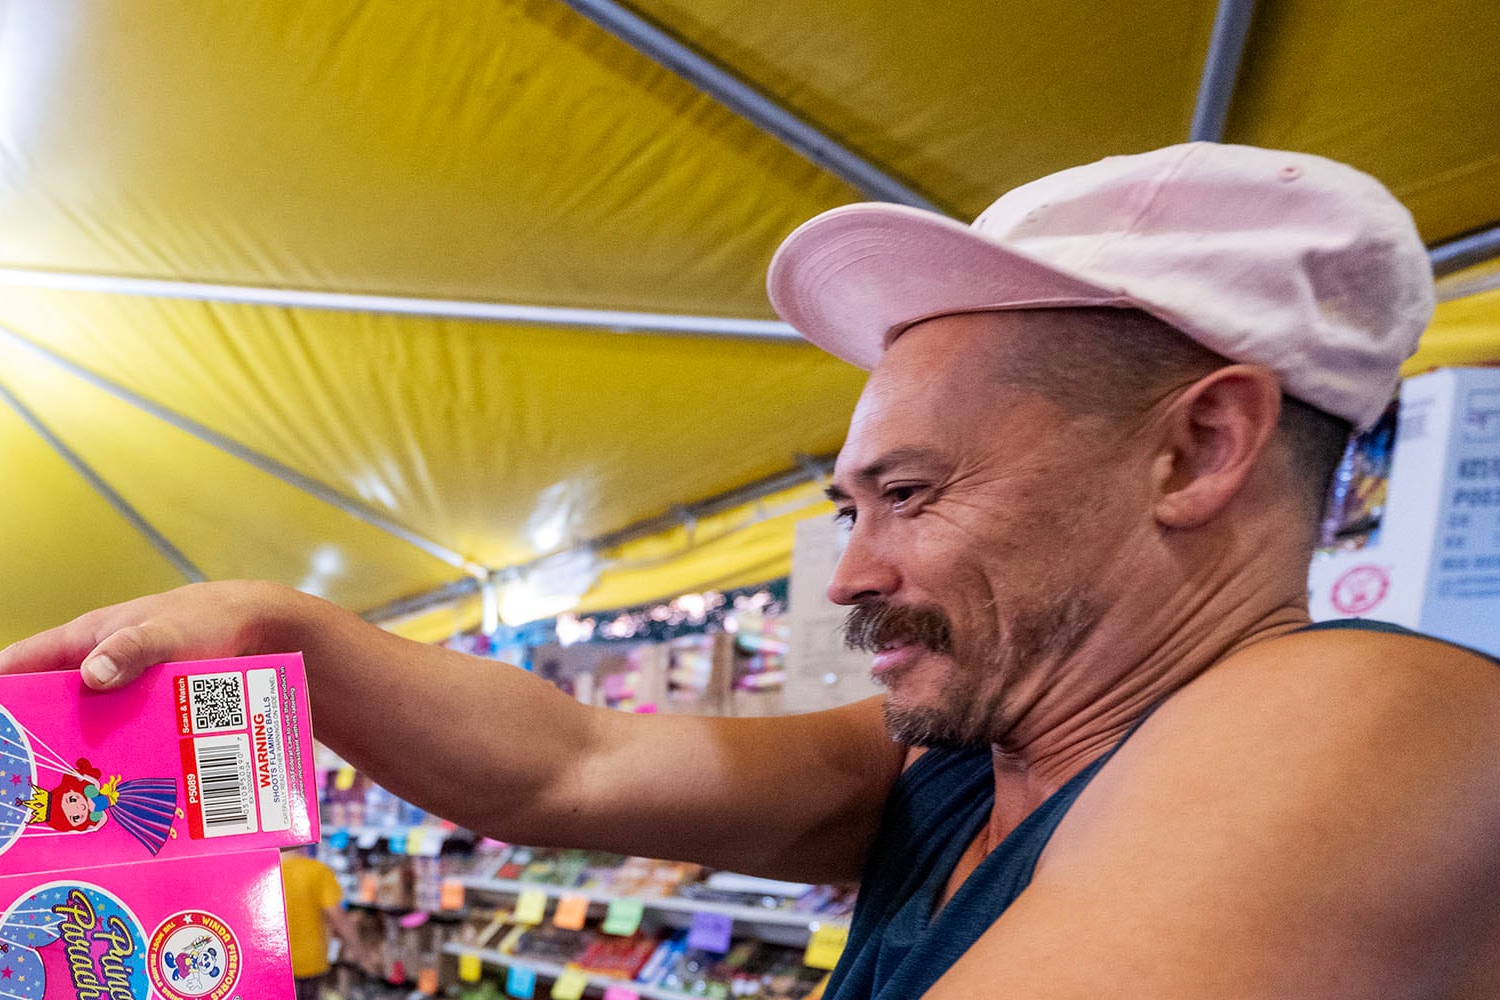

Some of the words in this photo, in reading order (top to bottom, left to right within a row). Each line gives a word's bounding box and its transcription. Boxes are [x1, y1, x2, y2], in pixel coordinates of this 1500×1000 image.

[177, 677, 187, 702] Watch
[279, 674, 288, 699] product
[181, 713, 190, 733] Scan
[263, 696, 272, 724] BALLS
[253, 712, 271, 787] WARNING
[266, 726, 276, 765] FLAMING
[287, 749, 296, 773] Federal
[187, 773, 198, 803] P5089
[270, 767, 280, 802] SHOOTS
[290, 774, 297, 782] of
[202, 916, 231, 942] WINDA
